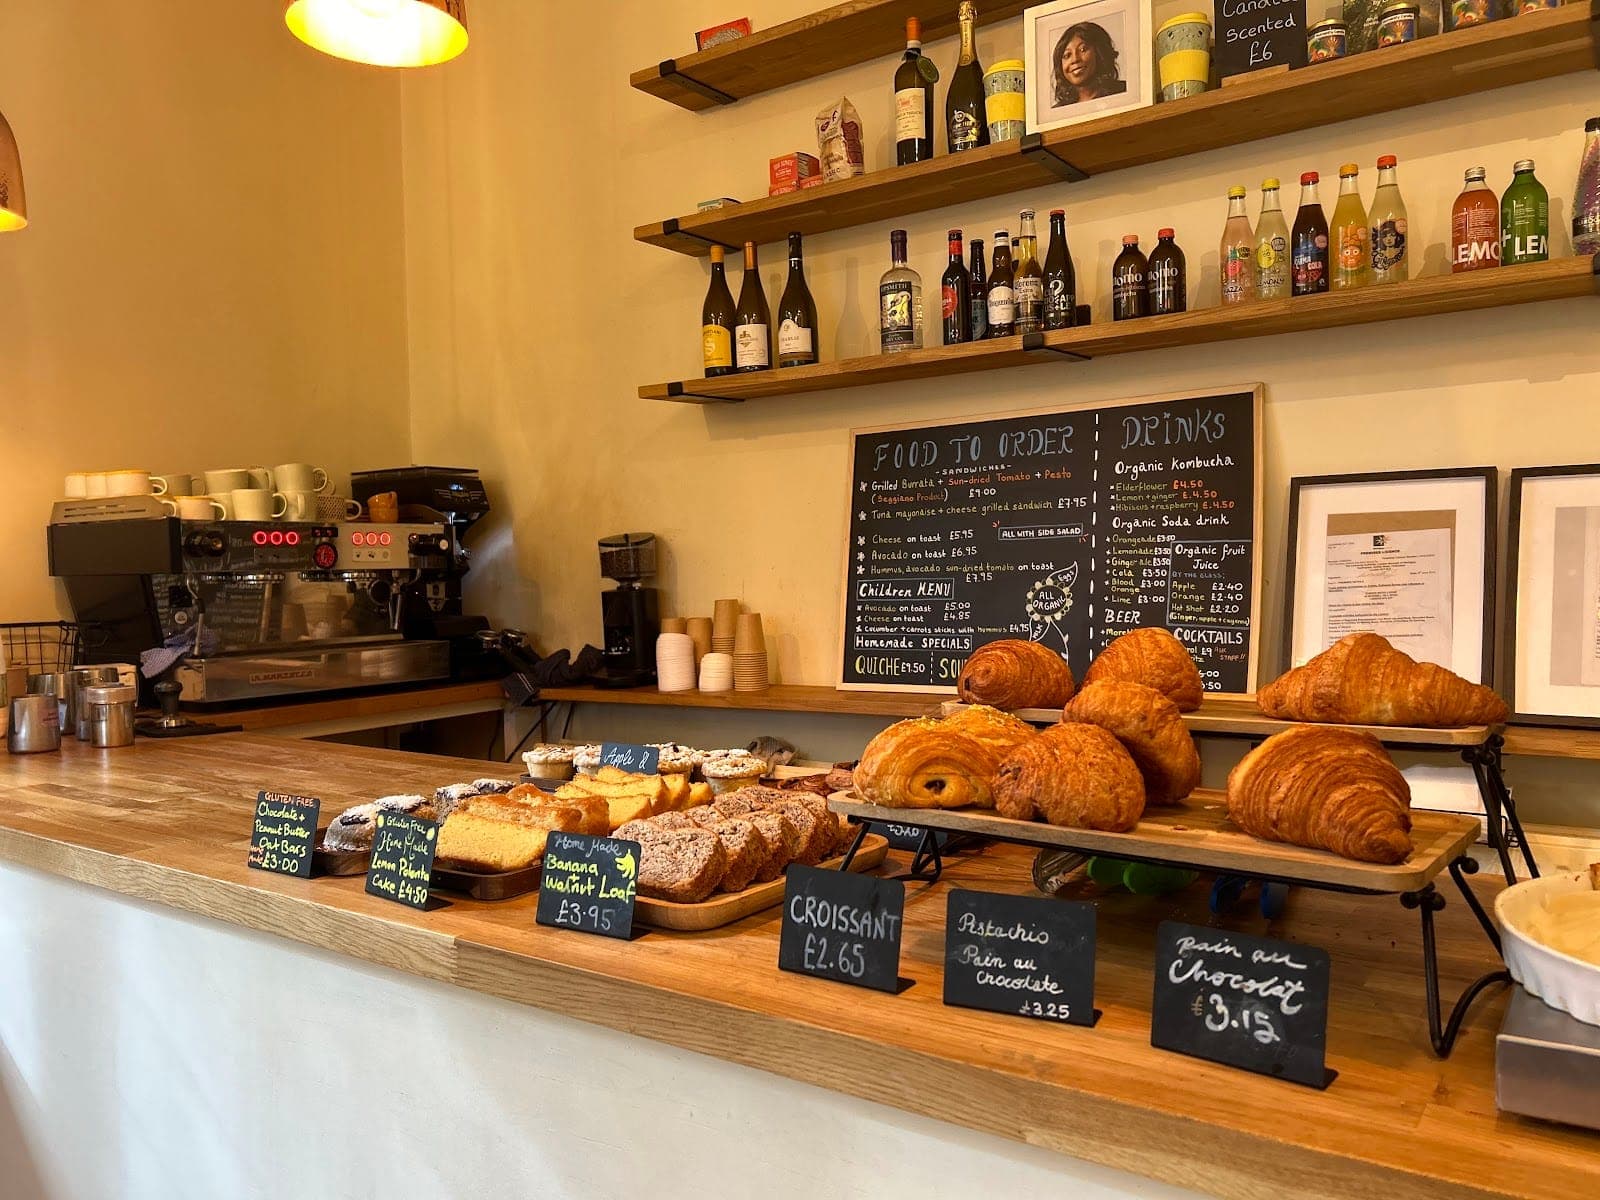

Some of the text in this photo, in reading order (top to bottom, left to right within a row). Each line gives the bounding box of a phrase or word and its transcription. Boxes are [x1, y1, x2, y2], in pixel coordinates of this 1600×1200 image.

[1226, 13, 1297, 42] Scented
[1249, 40, 1273, 66] £6
[1121, 408, 1226, 449] DRINKS
[873, 425, 1074, 471] FOOD TO ORDER
[1114, 454, 1234, 481] Organic Kombucha
[871, 480, 898, 491] Grilled
[996, 471, 1031, 482] Tomato
[1044, 466, 1072, 479] Pesto
[1115, 482, 1168, 492] Elderflower
[872, 509, 891, 520] Tuna
[946, 504, 977, 514] cheese
[981, 501, 1010, 516] grilled
[1012, 500, 1053, 511] sandwich
[1057, 497, 1087, 509] £7.95
[1002, 526, 1081, 538] ALL WITH SIDE SALAD
[1112, 513, 1229, 533] Organic Soda drink
[872, 534, 902, 544] Cheese
[920, 533, 942, 543] toast
[949, 529, 974, 541] £5.95
[871, 546, 977, 561] Avocado on toast £6.95
[1112, 547, 1155, 555] Lemonade
[1175, 544, 1245, 562] Organic fruit
[986, 562, 1015, 571] tomato
[1031, 562, 1055, 571] toast
[1142, 569, 1167, 577] £3.50
[1192, 559, 1219, 570] Juice
[966, 572, 993, 583] £7.95
[1111, 578, 1166, 588] Blood £3.00
[1172, 581, 1243, 591] Apple £2.40
[917, 581, 952, 597] MENU
[1039, 591, 1055, 601] ALL
[1111, 586, 1140, 595] Orange
[1171, 592, 1243, 601] Orange £2.40
[864, 604, 897, 613] Avocado
[911, 603, 932, 612] toast
[944, 602, 971, 611] £5.00
[1032, 596, 1066, 611] ORGANIC
[1111, 595, 1165, 604] Lime £3.00
[1210, 604, 1240, 613] £2.20
[864, 615, 890, 624] Cheese
[904, 614, 924, 622] toast
[944, 611, 971, 621] £4.85
[1104, 608, 1141, 624] BEER
[855, 636, 970, 649] Homemade SPECIALS
[1173, 628, 1244, 644] COCKTAILS
[1201, 647, 1213, 658] £9
[855, 655, 901, 676] QUICHE
[900, 662, 926, 674] £9.50
[265, 792, 315, 807] GLUTEN FREE
[258, 801, 299, 821] Chocolate
[255, 820, 311, 843] Peanut Butter
[259, 837, 307, 857] Oat Bars
[555, 836, 622, 858] Home Made
[262, 851, 299, 872] £3.00
[371, 855, 429, 881] Lemon Polenta
[546, 853, 599, 876] Banana
[372, 874, 428, 904] Cake £4.50
[545, 875, 636, 904] Walnut Loaf
[555, 899, 616, 930] £3.95
[790, 895, 900, 941] CROISSANT
[959, 913, 1049, 944] Pistachio
[804, 932, 865, 978] £2.65
[959, 945, 1037, 970] Pain au
[1251, 949, 1307, 968] au
[1169, 959, 1305, 1015] Chocolat
